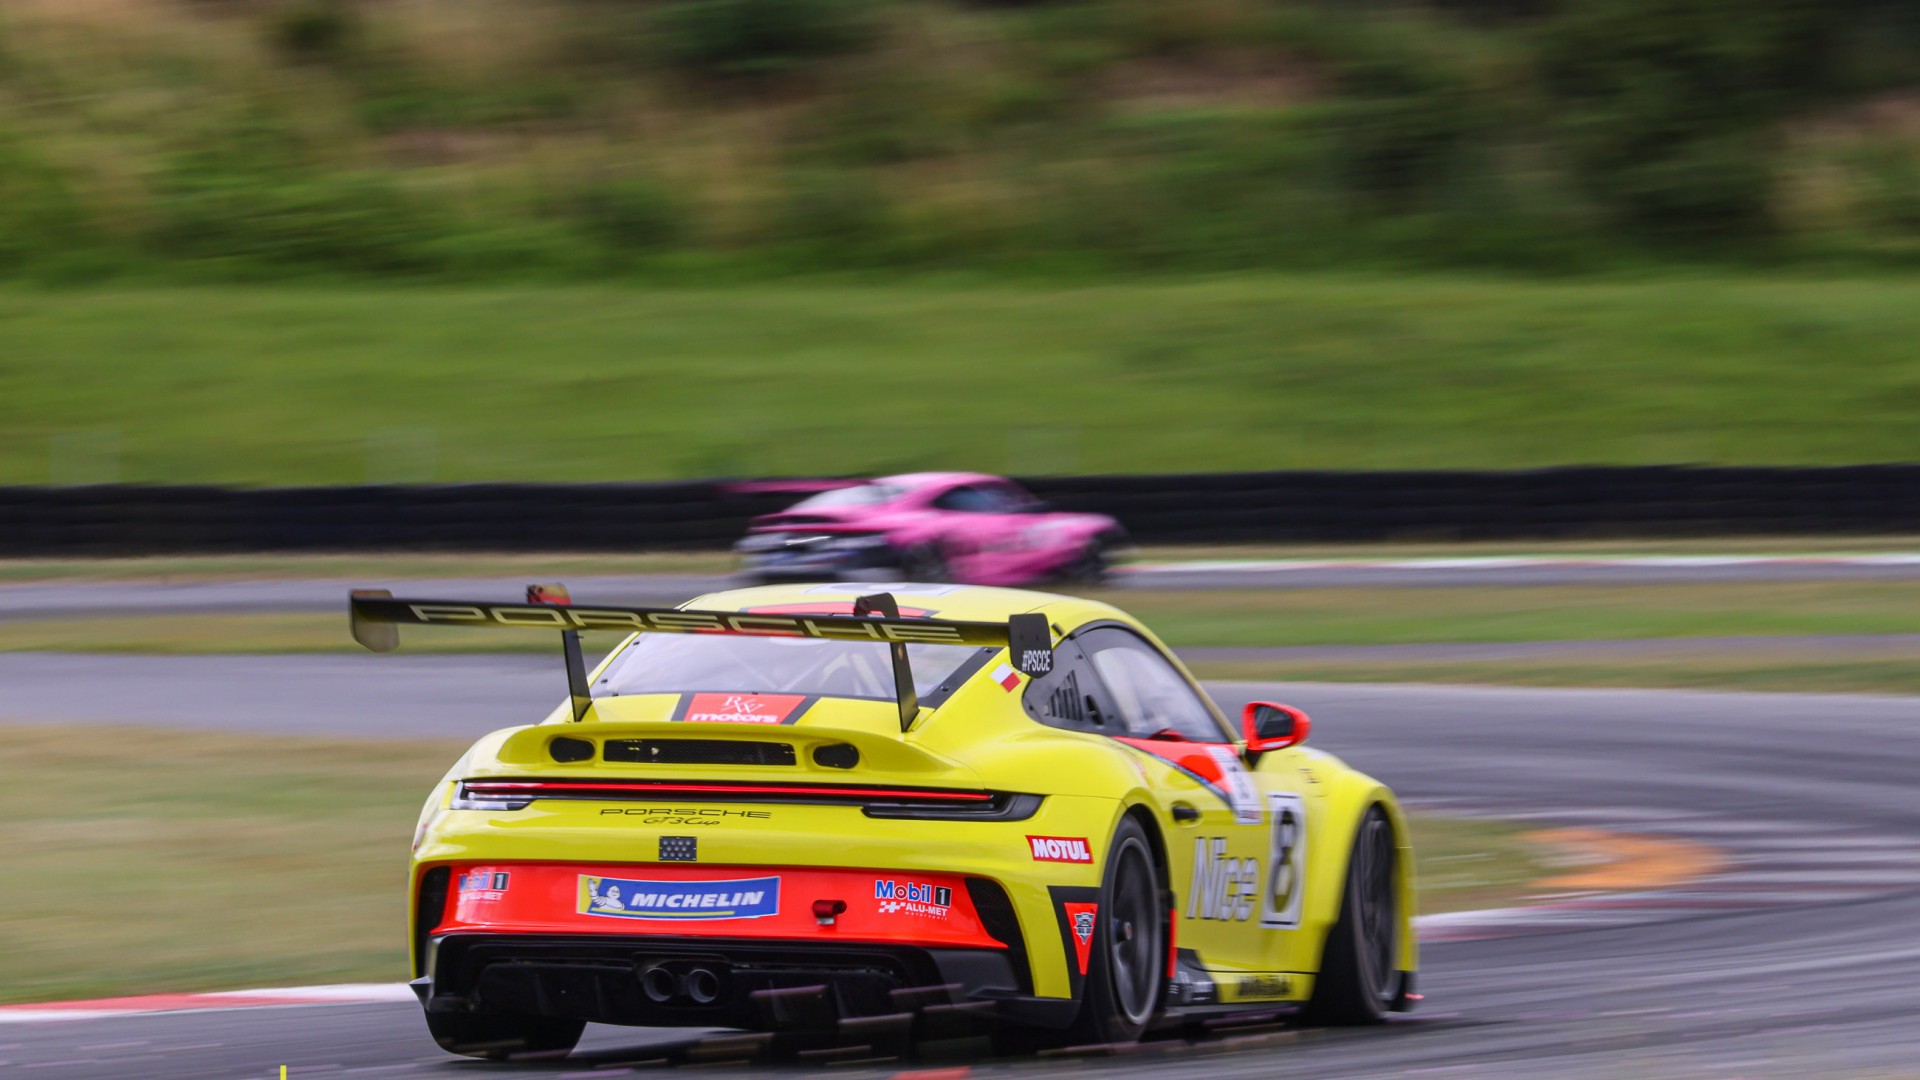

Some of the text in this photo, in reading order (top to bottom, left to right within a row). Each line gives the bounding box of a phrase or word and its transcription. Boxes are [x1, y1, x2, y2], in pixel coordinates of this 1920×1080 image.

[409, 603, 964, 643] PORSCHE
[1021, 650, 1051, 672] #PSCCE
[690, 713, 778, 723] motors
[599, 808, 772, 819] PORSCHE
[1032, 838, 1090, 861] MOTUL
[1270, 804, 1300, 914] 8
[1184, 836, 1260, 922] Nice
[629, 891, 765, 908] MICHELIN
[875, 880, 932, 903] Mobil
[905, 902, 948, 917] ALU-MET
